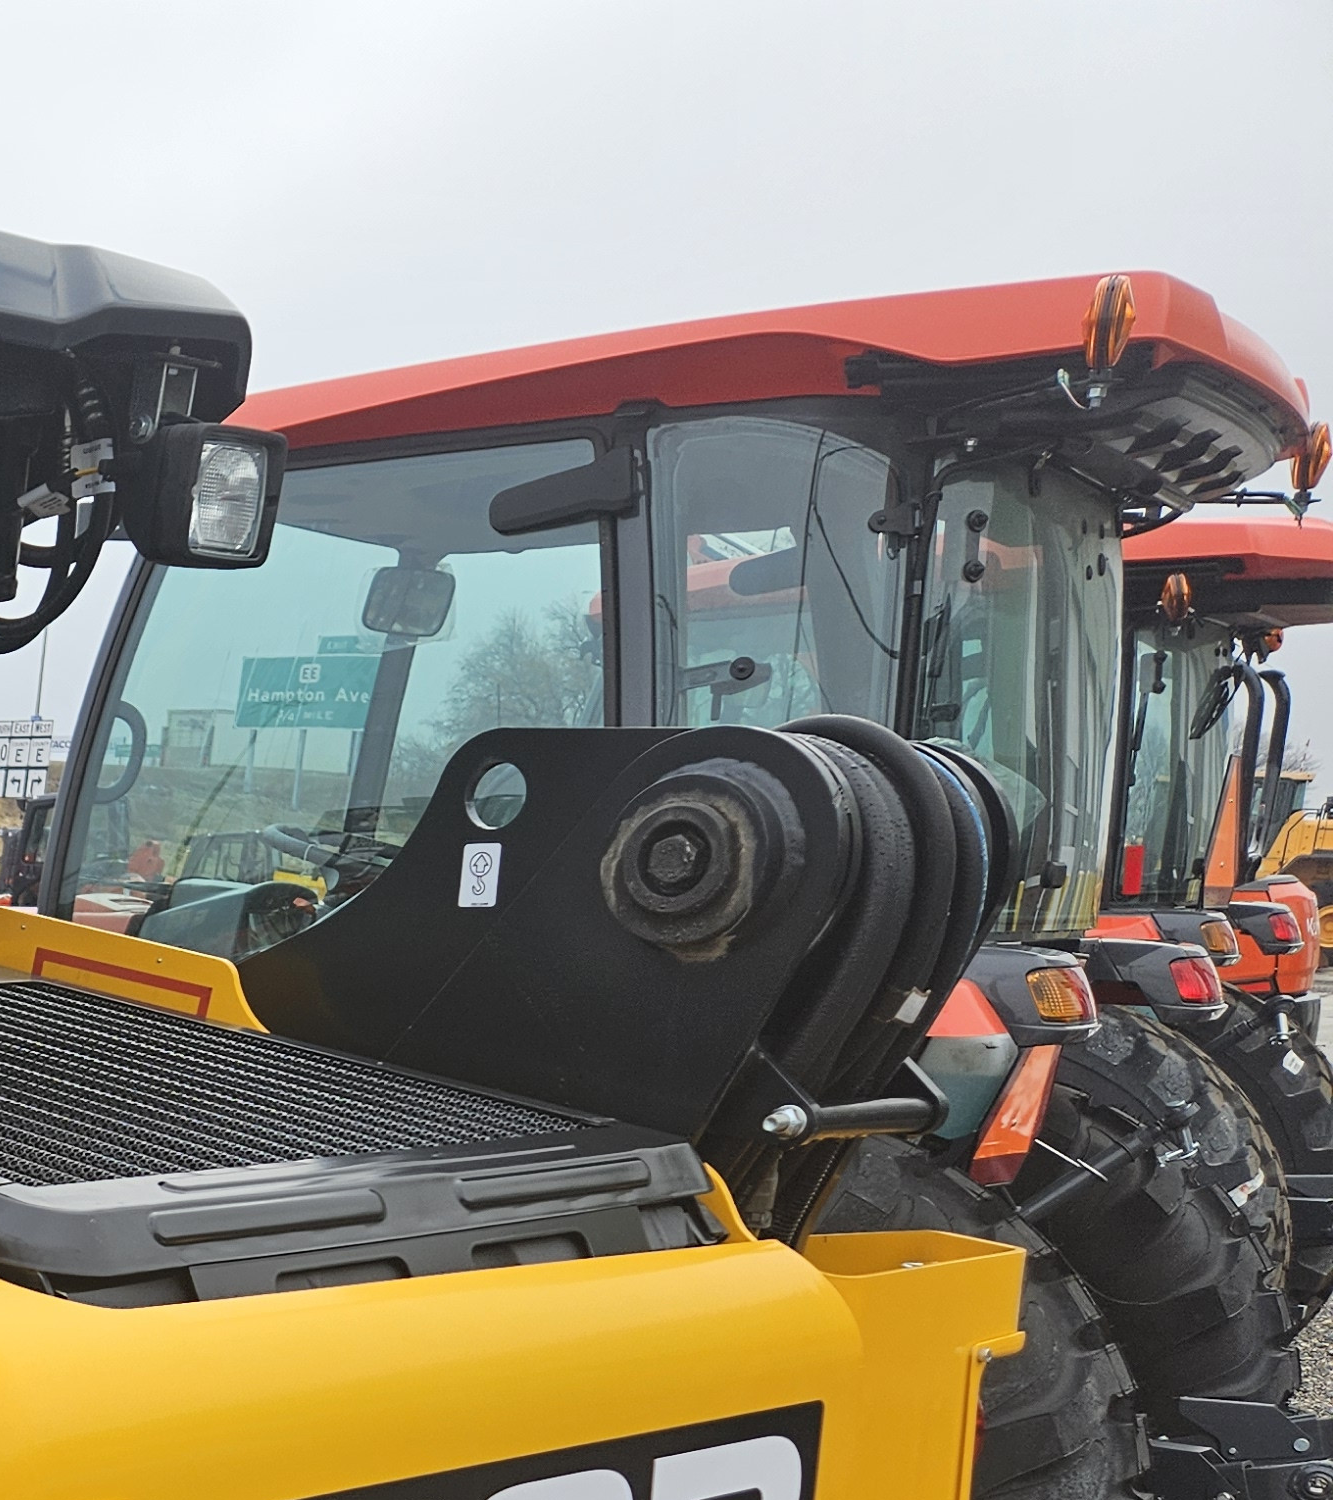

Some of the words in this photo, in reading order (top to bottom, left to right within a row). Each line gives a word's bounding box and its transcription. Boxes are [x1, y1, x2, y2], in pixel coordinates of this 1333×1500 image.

[301, 667, 318, 680] EE
[247, 688, 325, 704] Hampton
[335, 687, 370, 703] Ave
[303, 711, 334, 721] MILE
[14, 724, 30, 734] EAST
[35, 724, 51, 733] WEST
[15, 749, 24, 763] E
[36, 749, 45, 763] E
